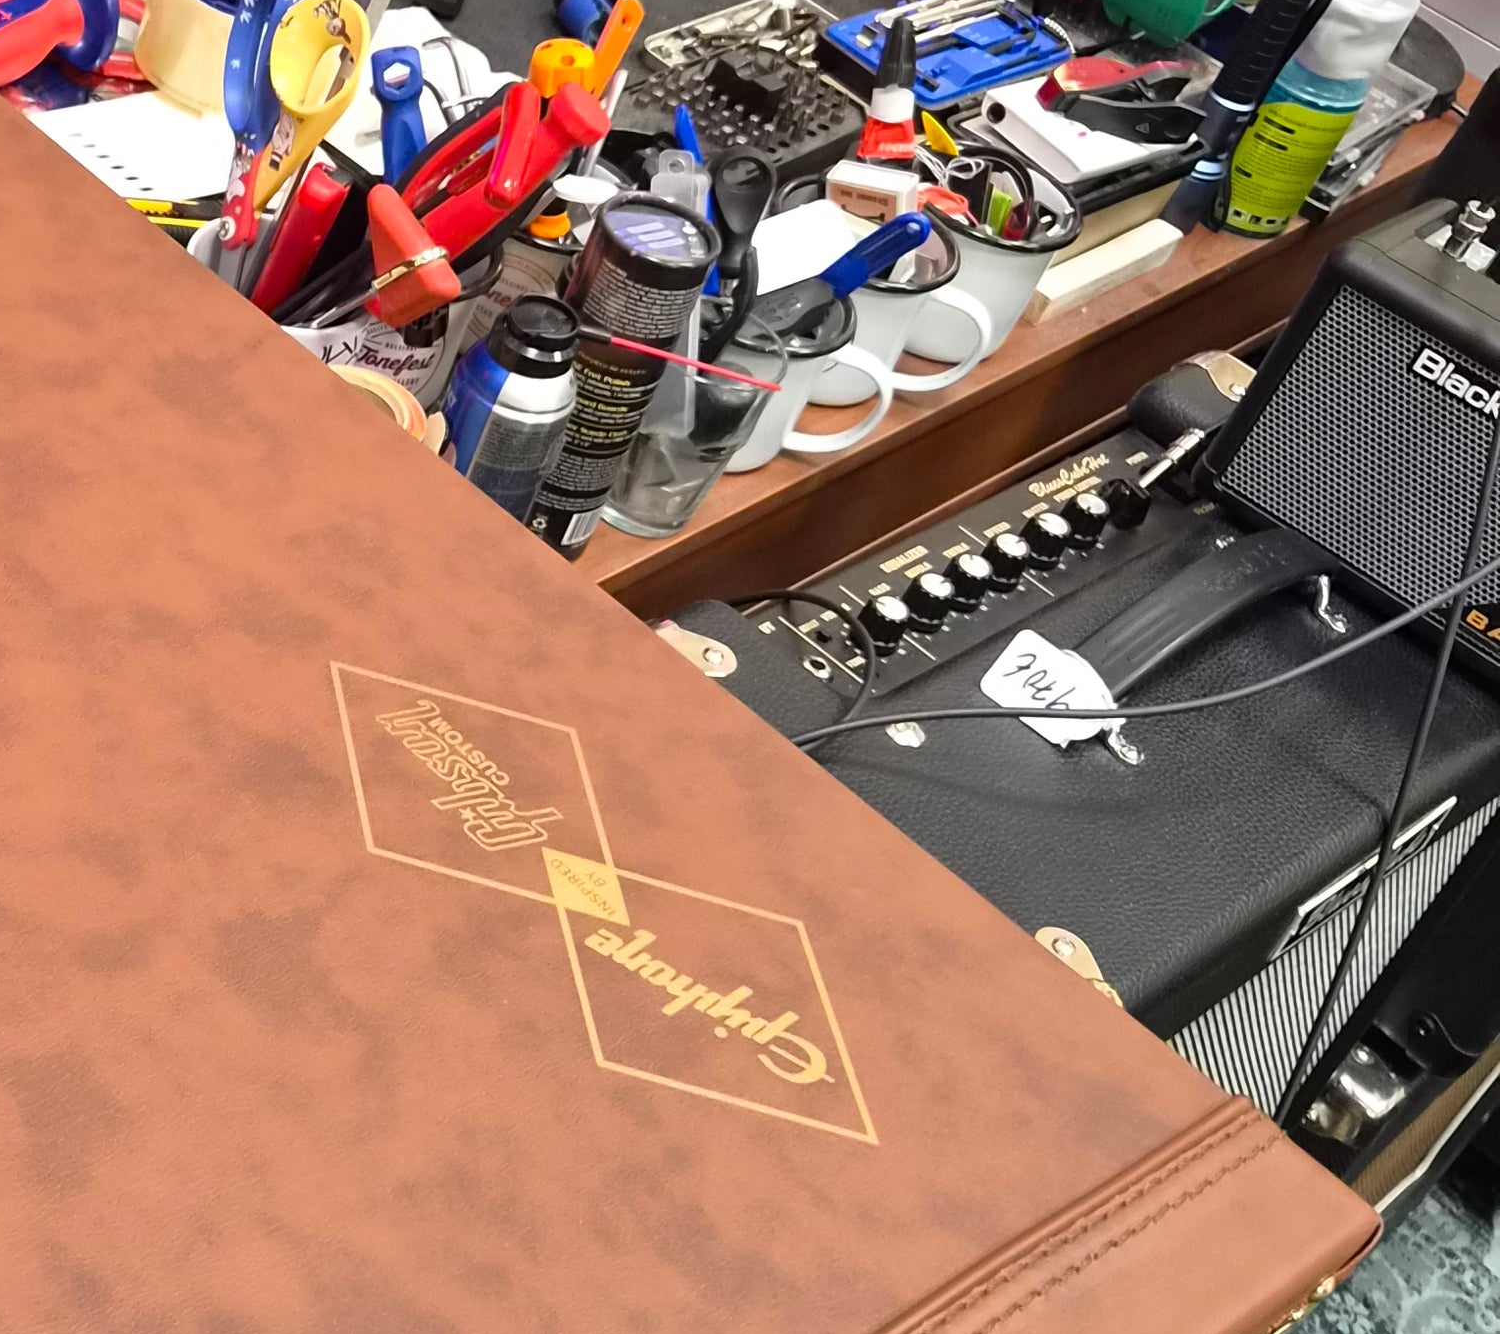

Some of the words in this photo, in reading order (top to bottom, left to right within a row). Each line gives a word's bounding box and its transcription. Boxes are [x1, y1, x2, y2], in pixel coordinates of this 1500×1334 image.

[357, 345, 435, 376] Tonefest
[375, 698, 565, 852] Gibson
[428, 716, 510, 786] CUSTOM
[550, 857, 617, 916] INSPIRED
[584, 870, 606, 888] BY
[583, 928, 836, 1085] Epiphone
